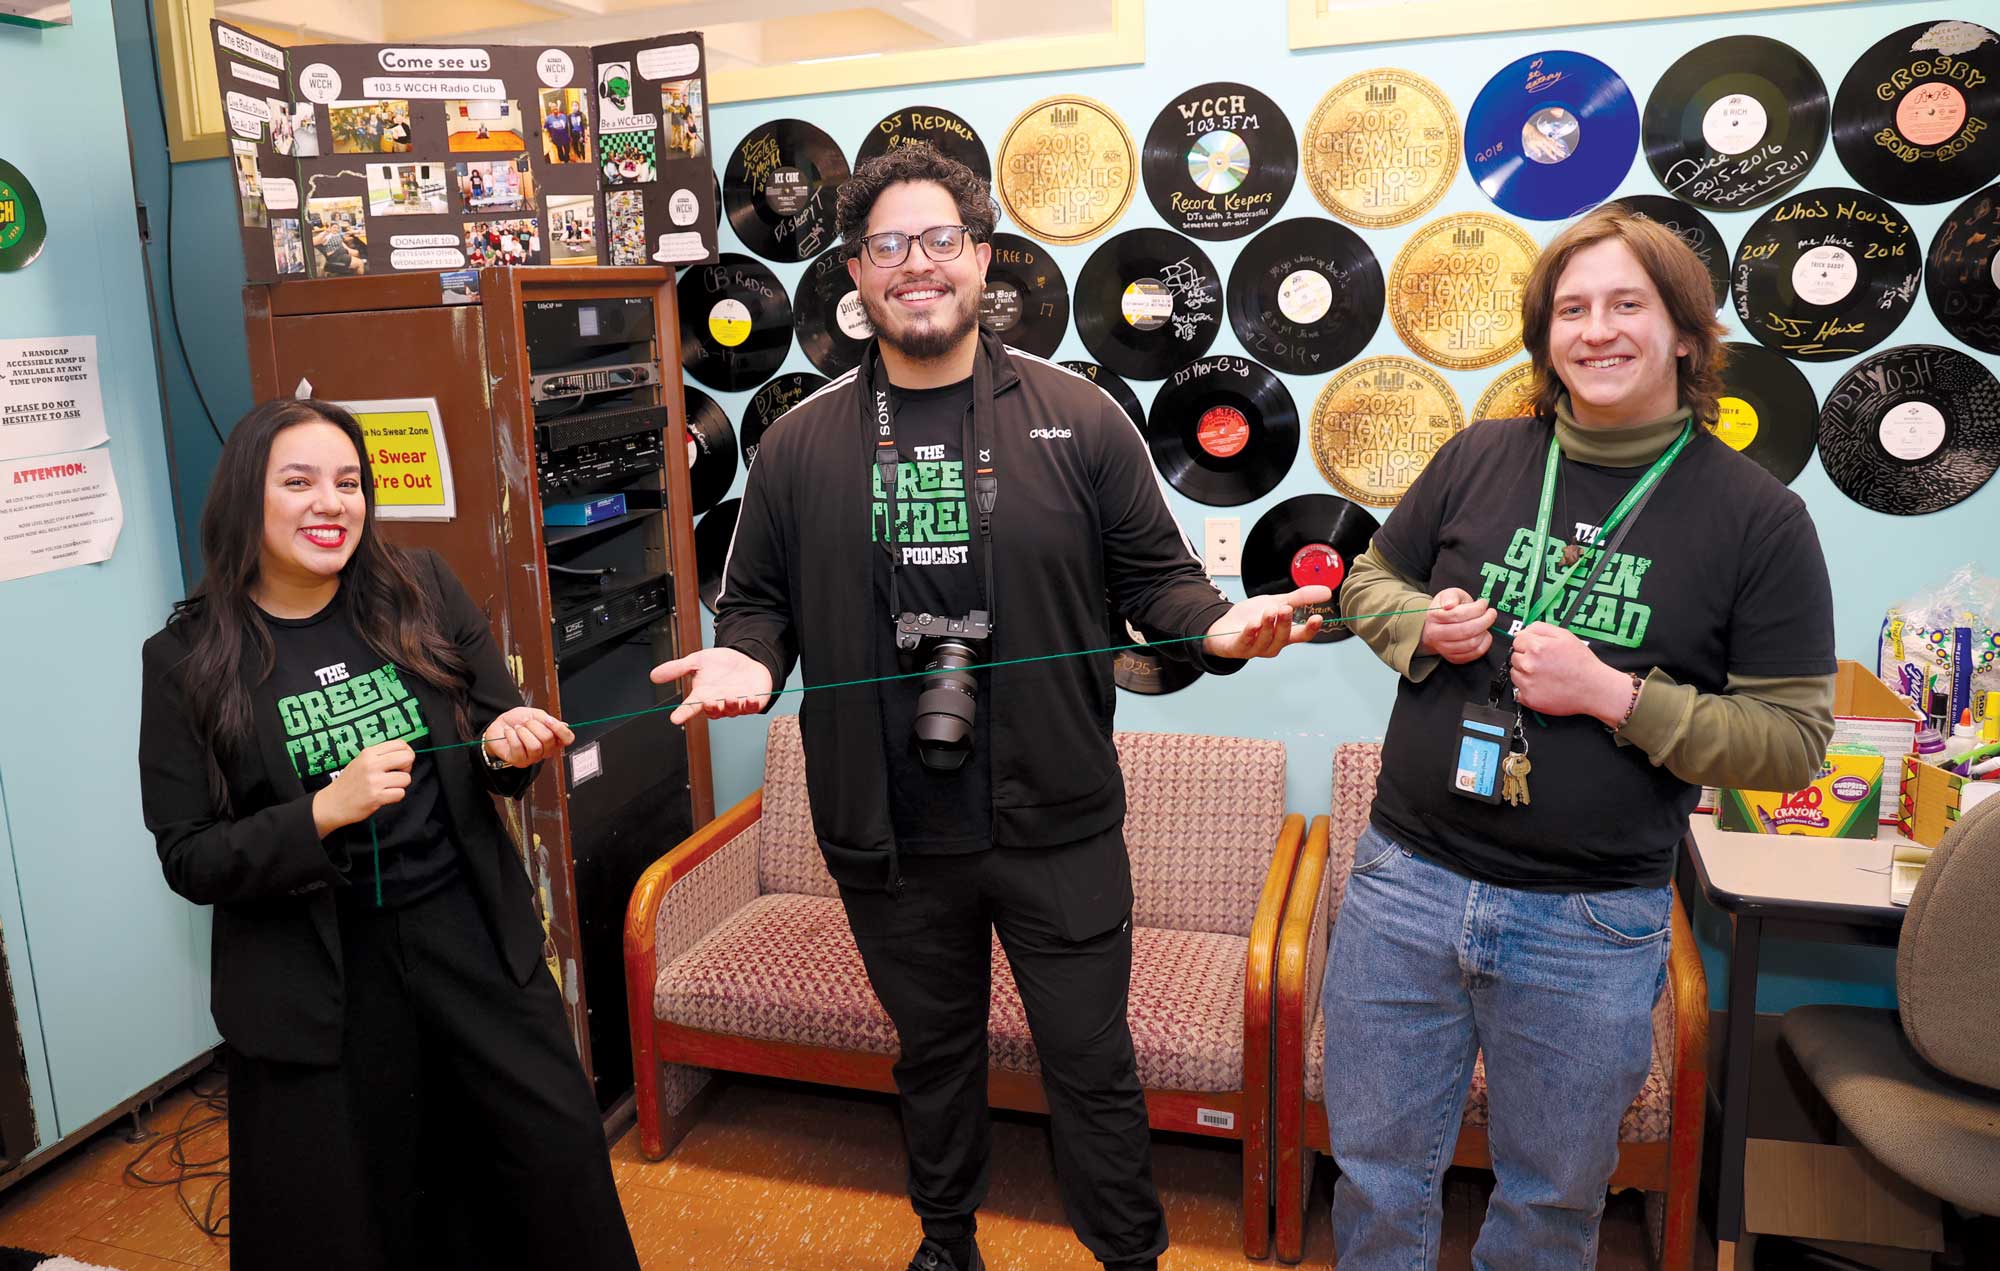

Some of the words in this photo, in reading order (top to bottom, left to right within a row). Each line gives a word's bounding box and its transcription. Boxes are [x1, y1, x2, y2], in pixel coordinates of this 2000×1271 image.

[223, 31, 235, 46] The
[236, 37, 252, 51] BEST
[260, 48, 279, 66] Variety
[383, 52, 433, 68] Come
[439, 57, 464, 68] see
[470, 57, 488, 69] us
[546, 64, 566, 73] WCCH
[309, 80, 332, 89] WCCH
[374, 82, 401, 93] 103.5
[404, 82, 438, 93] WCCH
[441, 82, 470, 94] Radio
[473, 82, 496, 93] Club
[1876, 56, 1986, 101] CROSBY
[1177, 95, 1246, 120] WCCH
[1730, 108, 1748, 116] RICH
[601, 118, 610, 128] Be
[618, 116, 644, 126] WCCH
[645, 114, 656, 125] DJ
[880, 114, 902, 134] DJ
[1346, 109, 1408, 132] 2019
[1037, 133, 1090, 154] 2018
[1315, 129, 1410, 153] AWARD
[1009, 152, 1094, 175] AWARD
[1339, 146, 1442, 168] SLIPMAT
[774, 172, 784, 184] ICE
[786, 172, 800, 183] CUBE
[1031, 167, 1123, 188] SLIPMAT
[1320, 167, 1427, 190] GOLDEN
[1664, 153, 1731, 194] Dice
[1693, 144, 1784, 198] 2015-2016
[1014, 185, 1109, 208] GOLDEN
[1170, 192, 1216, 213] Record
[1225, 192, 1272, 212] Keepers
[1363, 185, 1409, 208] THE
[676, 204, 692, 214] WCCH
[1052, 204, 1094, 224] THE
[1186, 212, 1203, 221] DJs
[1206, 211, 1224, 220] with
[1226, 212, 1232, 220] 2
[1234, 208, 1269, 218] successful
[1774, 200, 1829, 222] Who's
[1836, 201, 1910, 238] House?
[1182, 220, 1218, 229] semesters
[1222, 219, 1249, 228] on-air!
[395, 238, 440, 246] DONAHUE
[1742, 242, 1780, 261] 2014
[1864, 242, 1907, 259] 2016
[996, 248, 1020, 264] FREE
[1025, 252, 1034, 264] D
[1434, 252, 1500, 274] 2020
[703, 266, 730, 293] CB
[1401, 272, 1498, 294] AWARD
[1424, 290, 1523, 312] SLIPMAT
[1405, 310, 1514, 332] GOLDEN
[1812, 318, 1865, 342] House
[1256, 332, 1306, 365] 2019
[1448, 328, 1494, 349] THE
[6, 358, 54, 368] ACCESSIBLE
[28, 349, 69, 357] HANDICAP
[12, 368, 55, 376] AVAILABLE
[54, 374, 88, 382] REQUEST
[1174, 366, 1190, 386] DJ
[1866, 356, 1933, 396] YOSH
[4, 404, 40, 414] PLEASE
[42, 402, 54, 410] DO
[876, 391, 890, 436] SONY
[1354, 394, 1416, 416] 2021
[2, 414, 48, 424] HESITATE
[64, 410, 80, 418] ASK
[1322, 411, 1416, 432] AWARD
[383, 428, 406, 436] Swear
[409, 427, 428, 435] Zone
[1030, 427, 1072, 439] adidas
[1347, 432, 1447, 451] SLIPMAT
[379, 449, 426, 464] Swear
[914, 444, 945, 460] THE
[1328, 449, 1432, 471] GOLDEN
[14, 463, 87, 484] ATTENTION:
[404, 474, 432, 488] Out
[1368, 467, 1413, 488] THE
[902, 546, 968, 566] PODCAST
[314, 662, 350, 686] THE
[278, 662, 408, 737] GREEN
[1834, 782, 1867, 790] SURPRISE
[1774, 806, 1823, 821] CRAYONS
